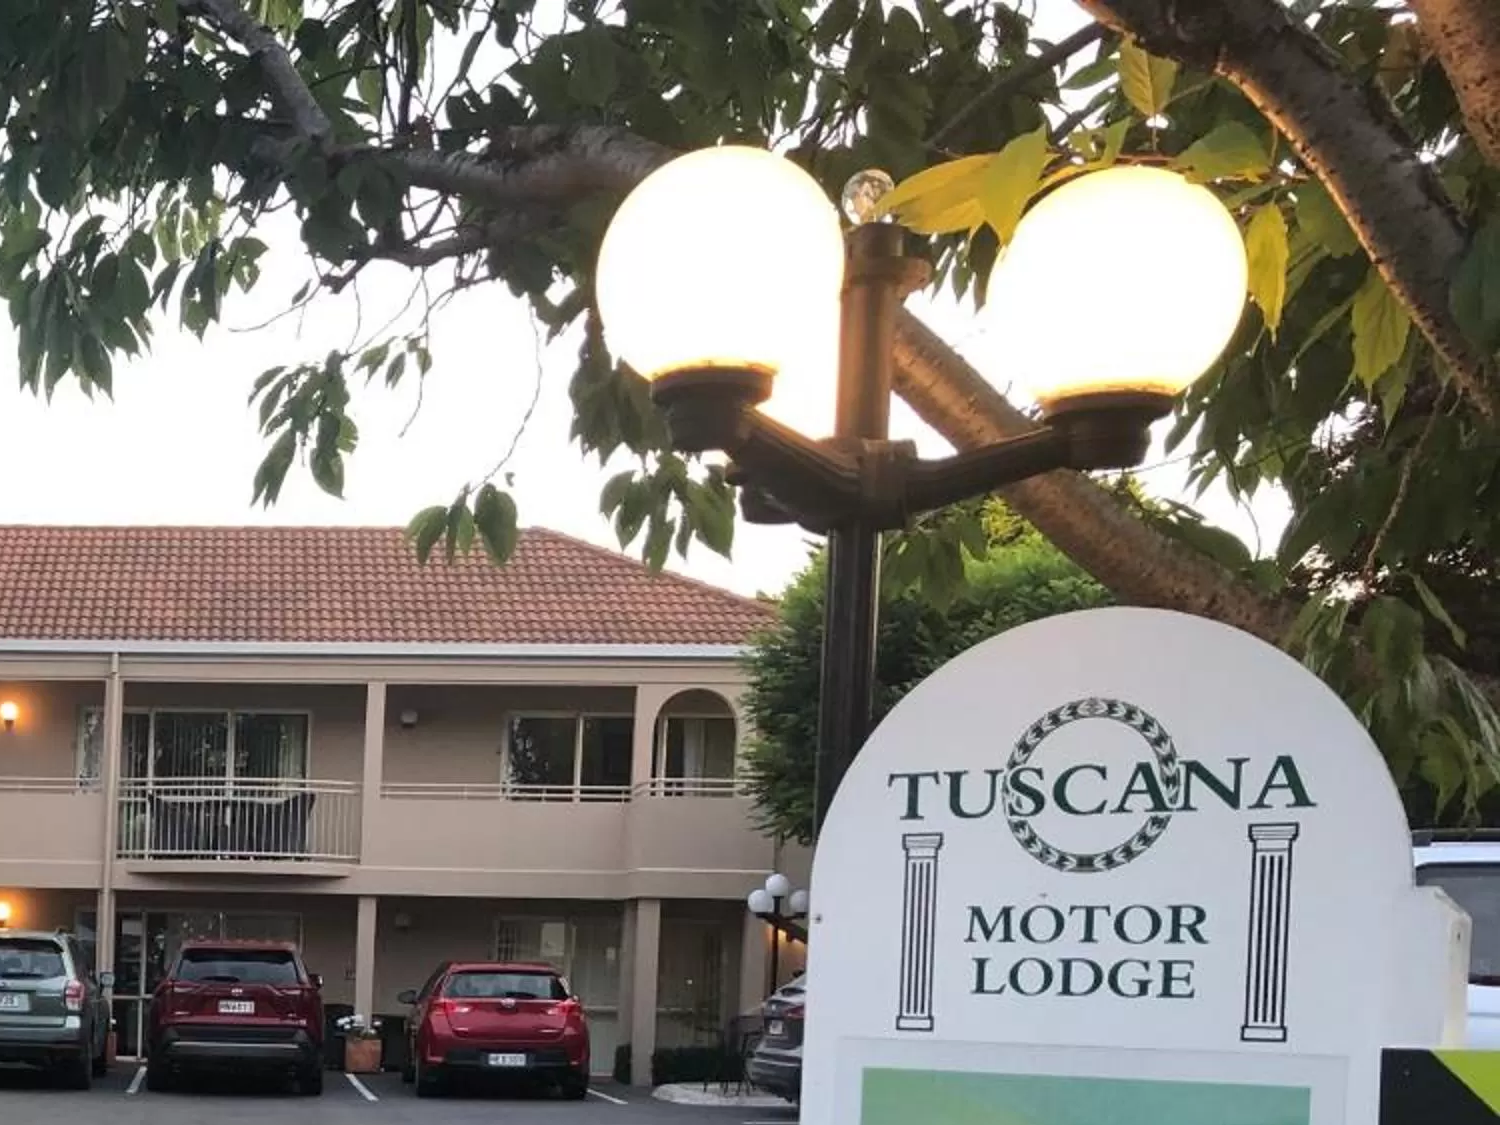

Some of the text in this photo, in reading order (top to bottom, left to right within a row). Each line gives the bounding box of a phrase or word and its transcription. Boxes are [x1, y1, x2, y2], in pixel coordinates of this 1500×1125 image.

[888, 754, 1317, 821] TUSCANA
[964, 904, 1209, 945] MOTOR
[971, 957, 1196, 999] LODGE
